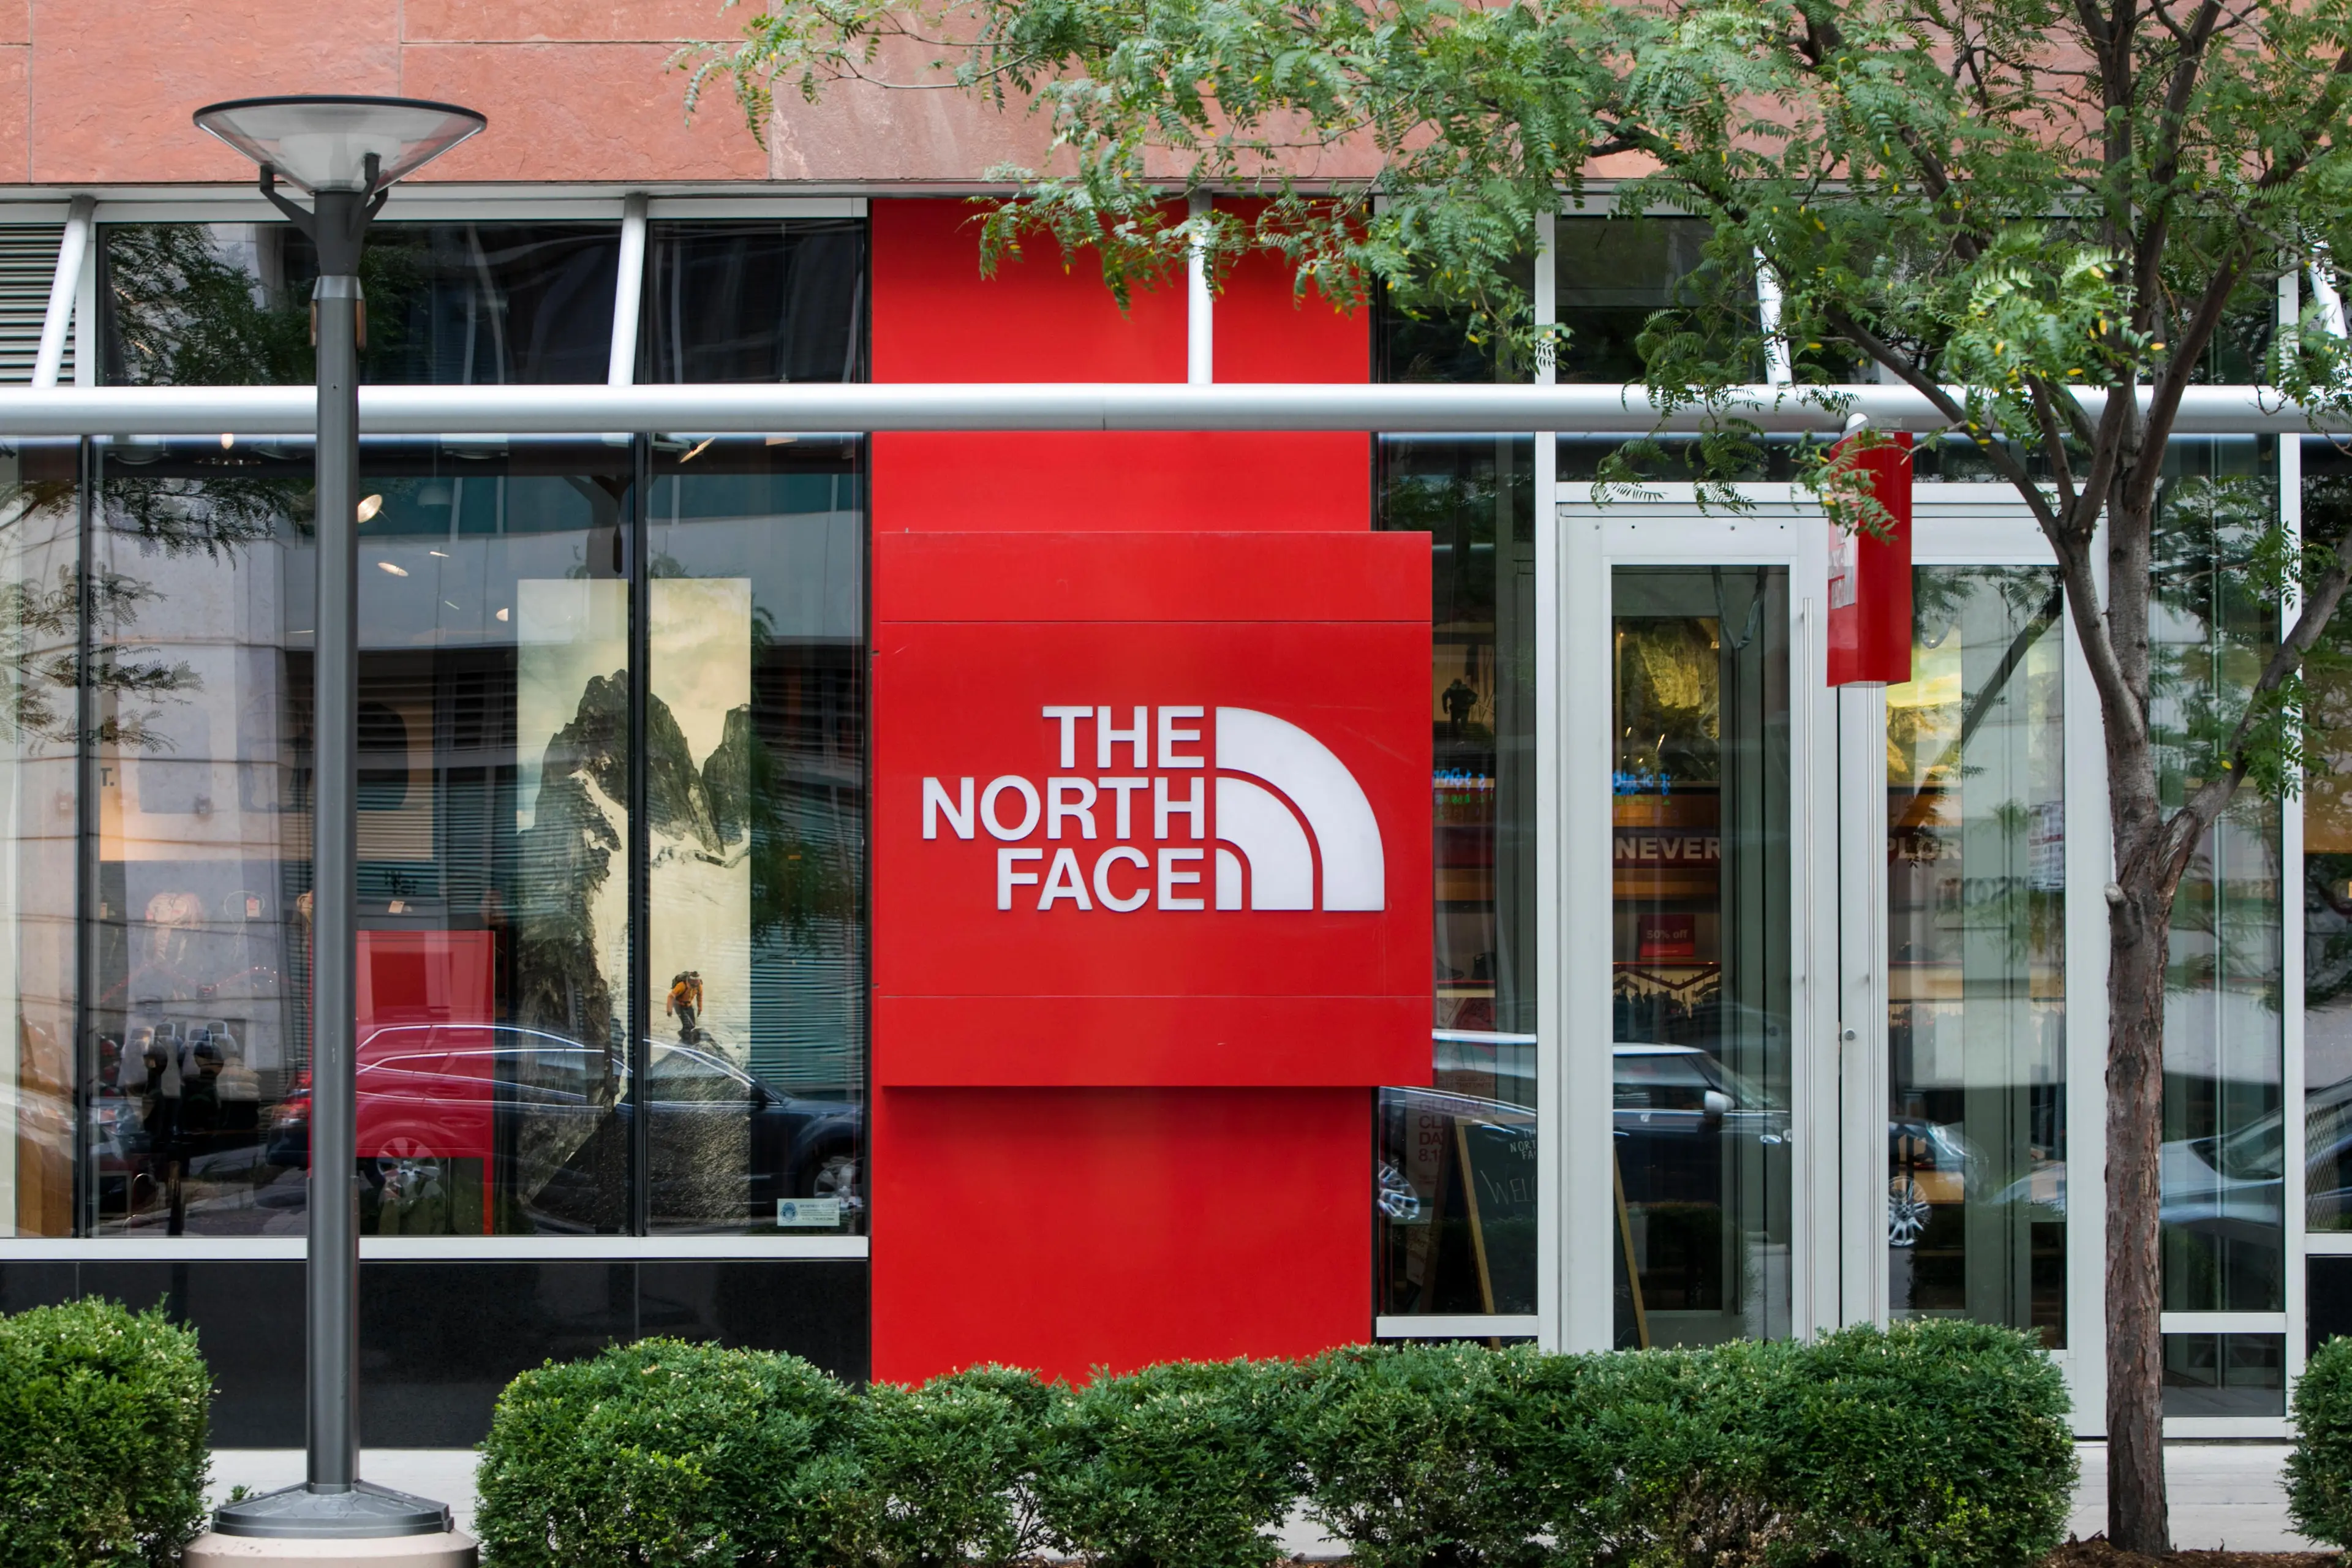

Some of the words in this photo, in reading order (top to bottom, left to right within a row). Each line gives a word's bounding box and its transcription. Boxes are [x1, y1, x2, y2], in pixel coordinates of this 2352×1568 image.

[1042, 706, 1205, 769] THE
[922, 774, 1205, 841] NORTH
[1615, 837, 1720, 860] NEVER
[997, 845, 1205, 913] FACE
[1646, 929, 1670, 940] 50%
[1673, 929, 1688, 940] off
[1419, 1132, 1444, 1145] DA
[1418, 1148, 1439, 1163] 8.1
[1521, 1150, 1536, 1160] FA
